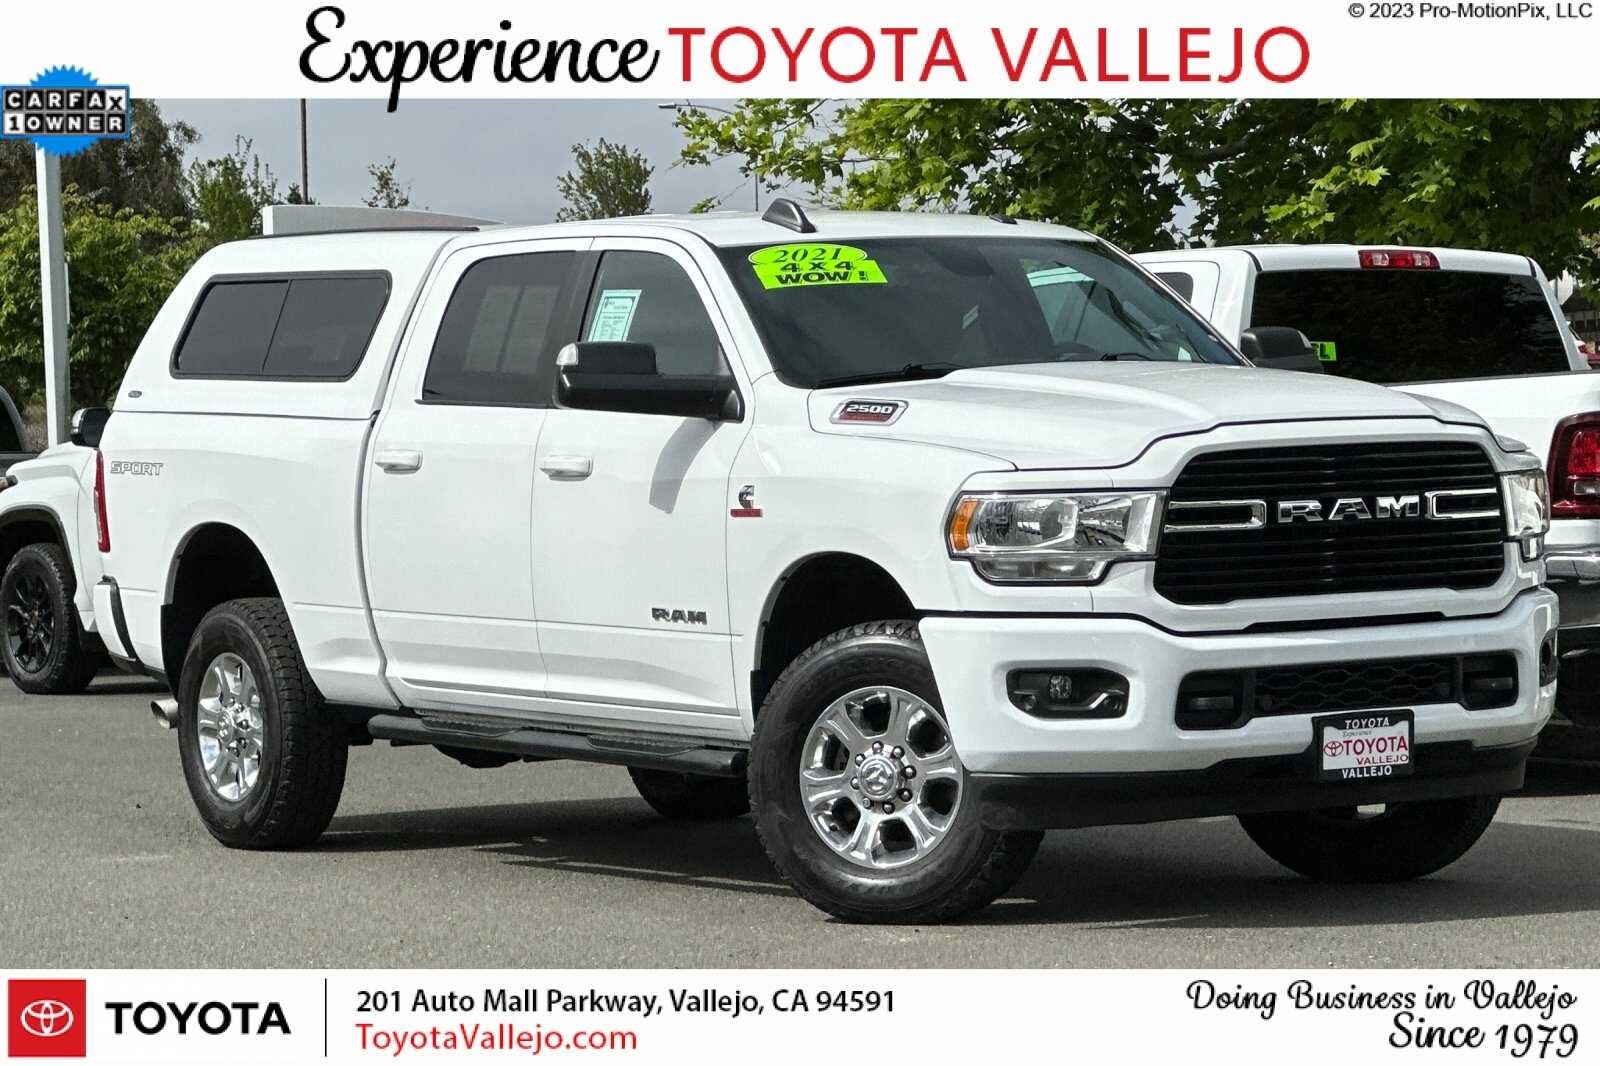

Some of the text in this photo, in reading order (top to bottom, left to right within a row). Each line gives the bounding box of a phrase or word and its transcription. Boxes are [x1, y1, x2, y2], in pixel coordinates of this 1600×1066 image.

[774, 247, 842, 263] 2021
[846, 404, 894, 414] 2500
[110, 461, 164, 476] SPORT
[1277, 495, 1420, 523] RAM
[651, 607, 708, 625] RAM
[1345, 717, 1390, 729] TOYOTA
[1343, 736, 1408, 756] TOYOTA
[1356, 754, 1409, 765] VALLEJO
[1342, 765, 1392, 779] VALLEJO
